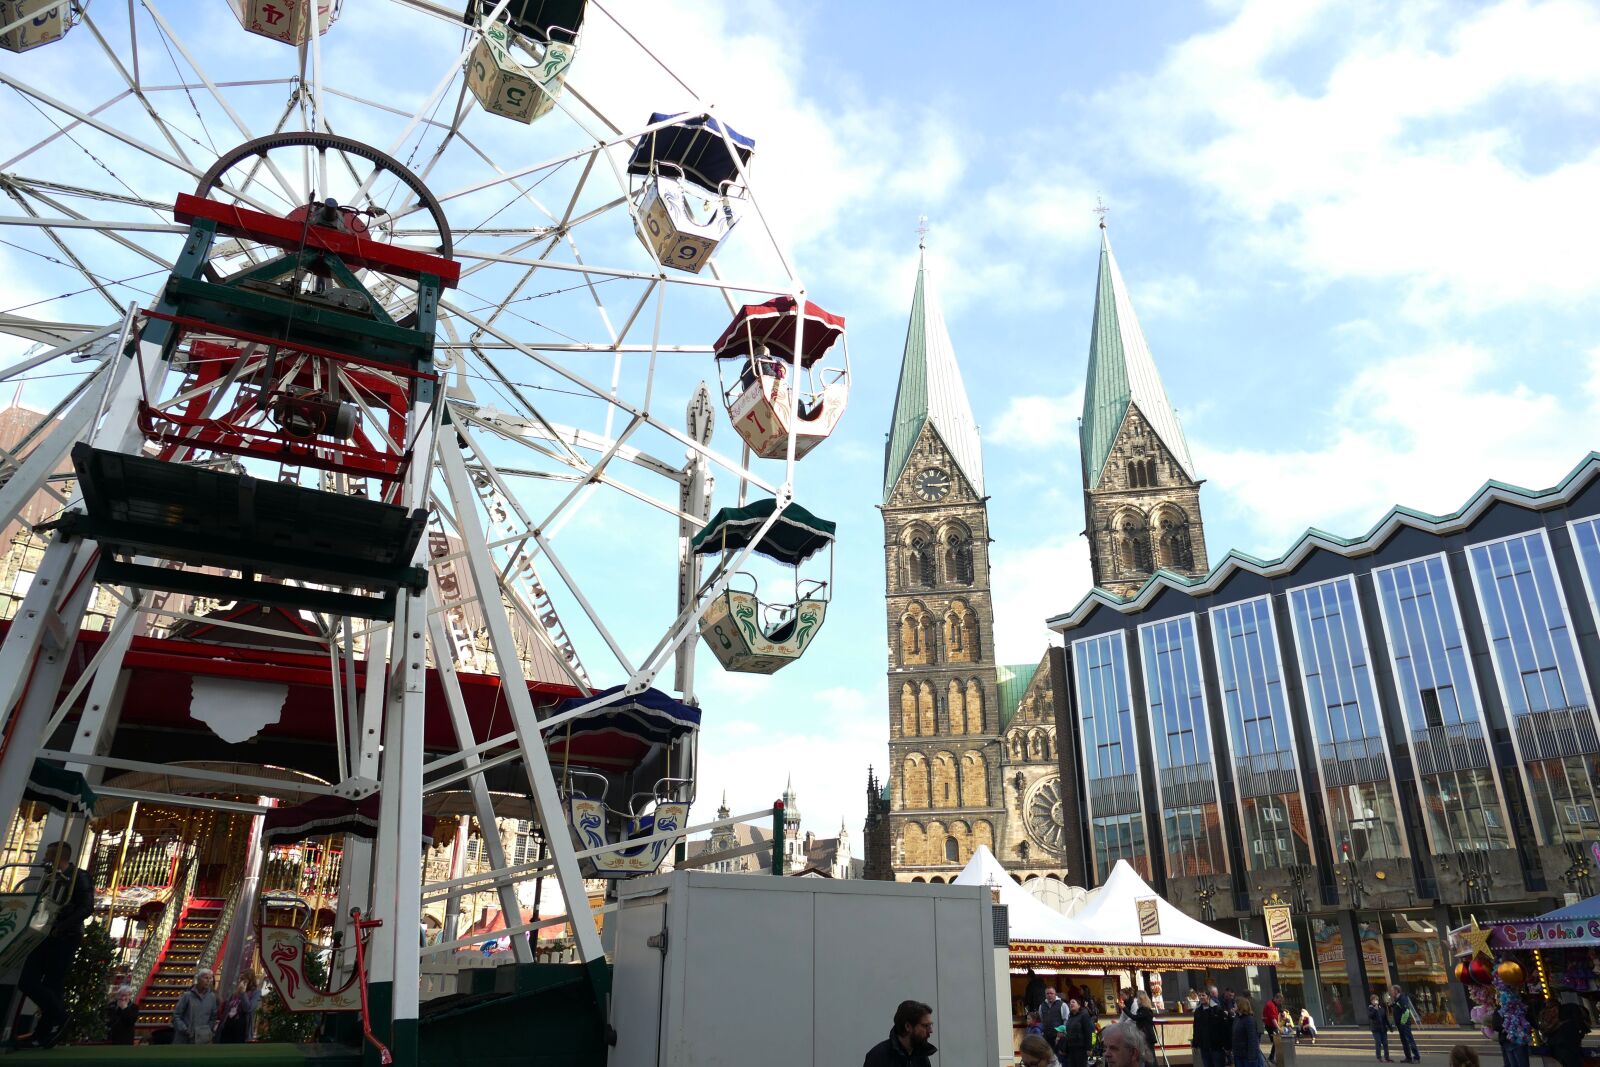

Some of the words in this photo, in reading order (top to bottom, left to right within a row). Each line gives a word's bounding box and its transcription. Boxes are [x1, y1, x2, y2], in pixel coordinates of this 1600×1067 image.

[506, 87, 526, 107] 5
[747, 411, 765, 433] 7
[714, 625, 732, 649] 8
[1503, 923, 1544, 947] Spiel
[1548, 922, 1584, 940] ohne
[1118, 947, 1175, 957] LUCULLUS
